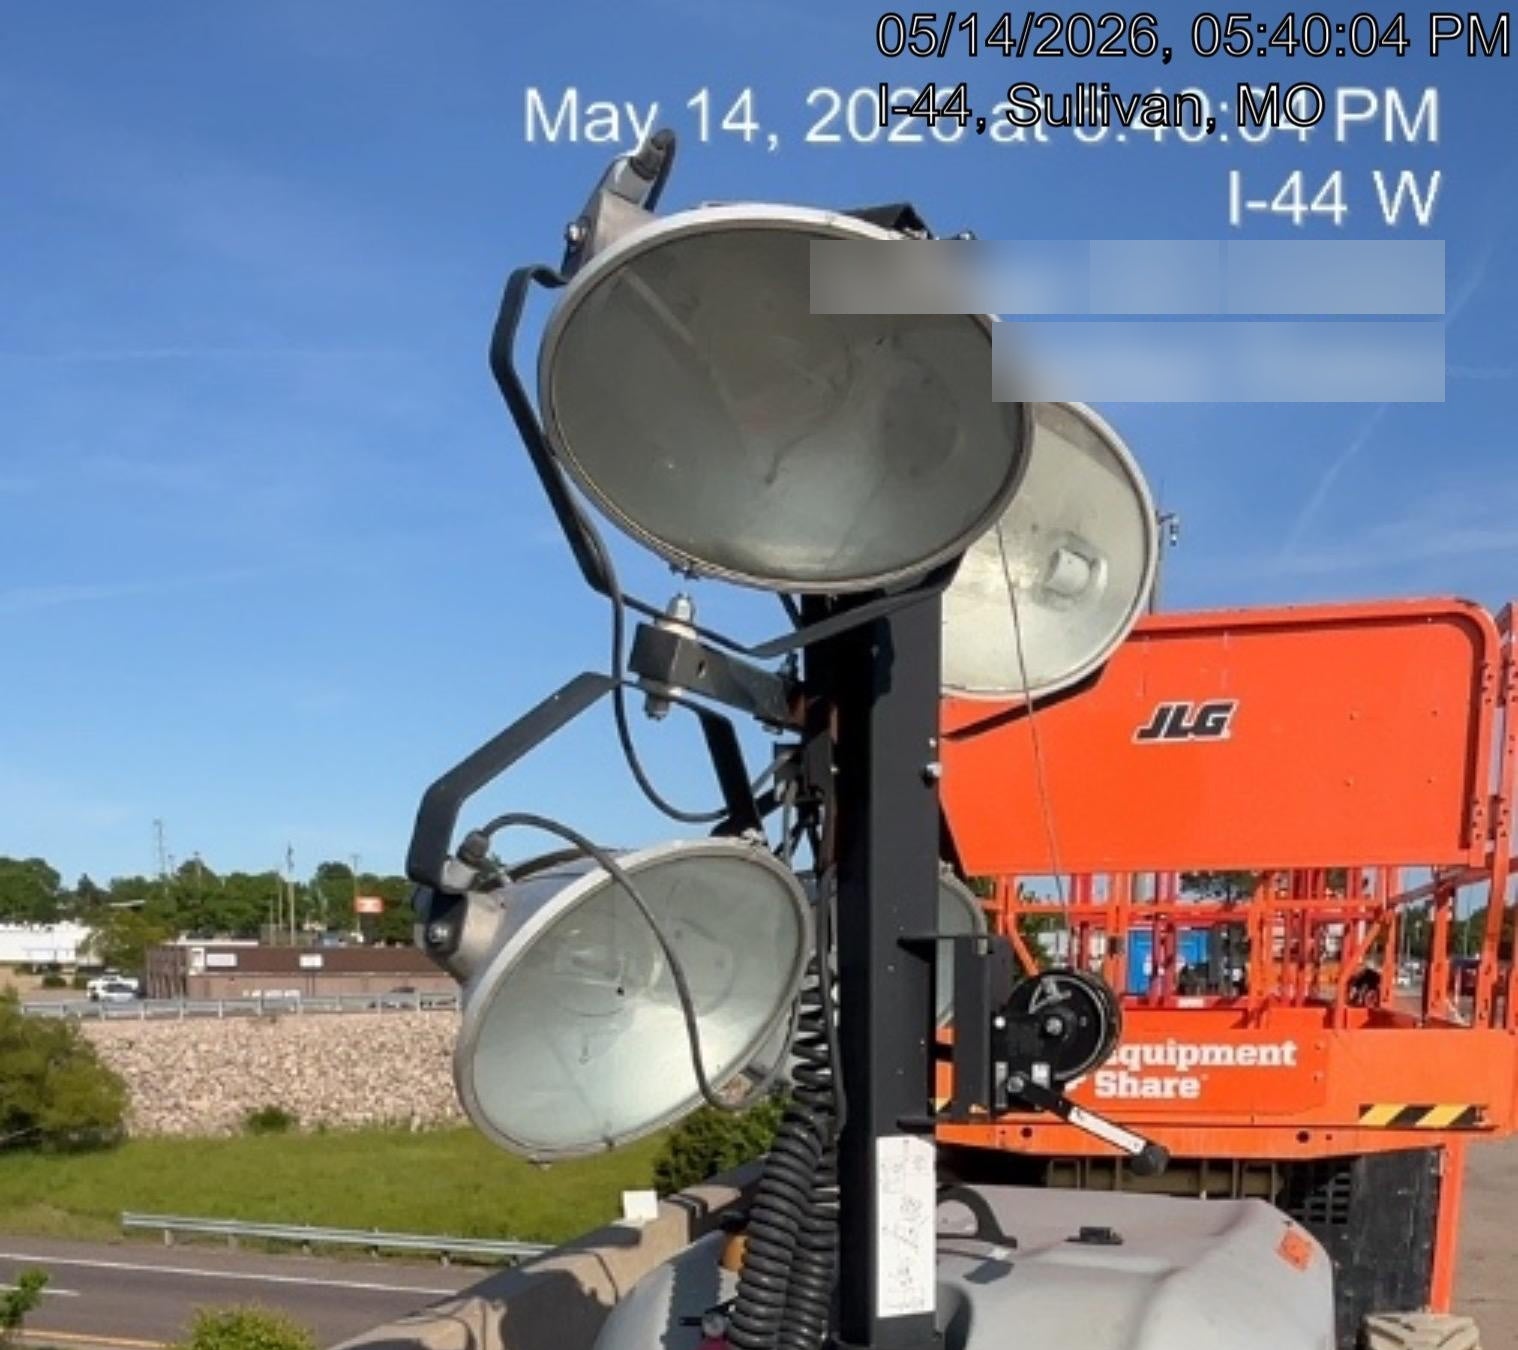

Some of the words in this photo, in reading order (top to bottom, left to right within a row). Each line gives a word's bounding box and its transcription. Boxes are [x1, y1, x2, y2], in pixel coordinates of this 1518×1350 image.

[1132, 699, 1239, 743] JLG
[1105, 1037, 1297, 1072] quipment
[1094, 1070, 1201, 1099] Share
